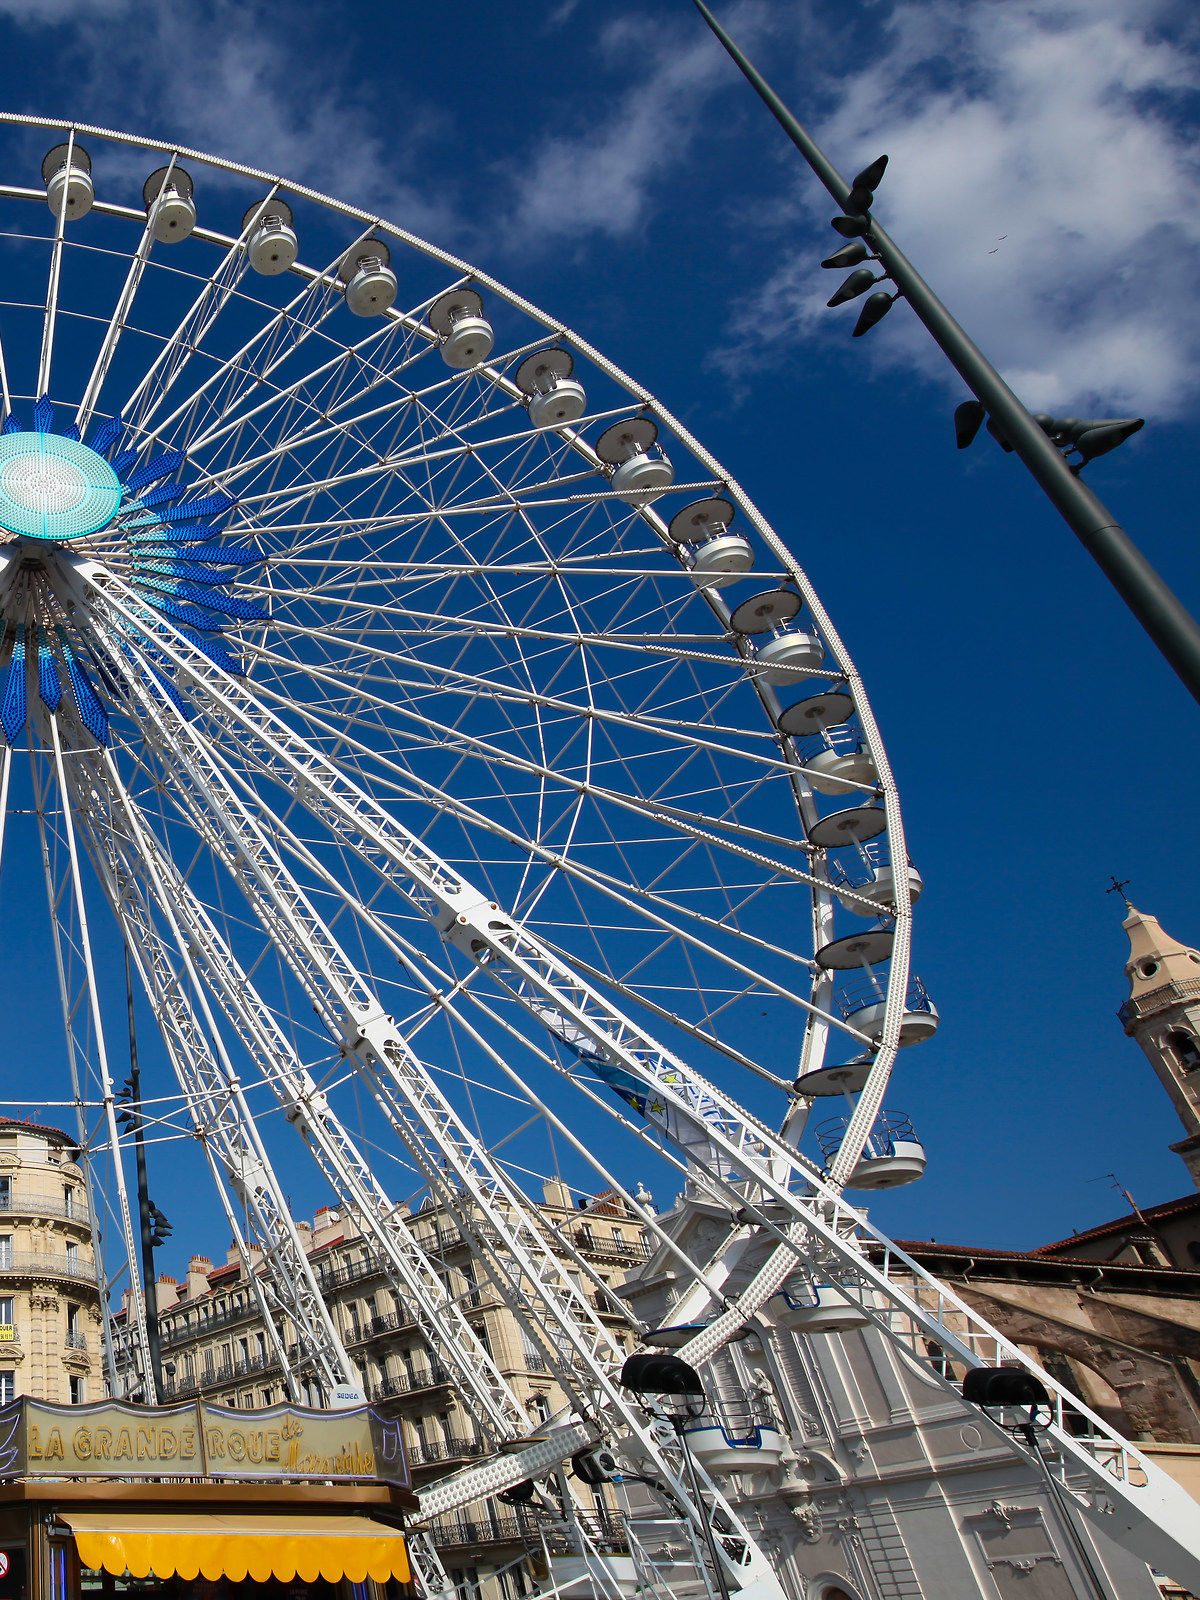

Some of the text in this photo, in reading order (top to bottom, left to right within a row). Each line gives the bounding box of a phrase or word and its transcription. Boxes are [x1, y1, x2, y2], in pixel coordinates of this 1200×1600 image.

[28, 1414, 304, 1463] LA GRANDE ROUE de
